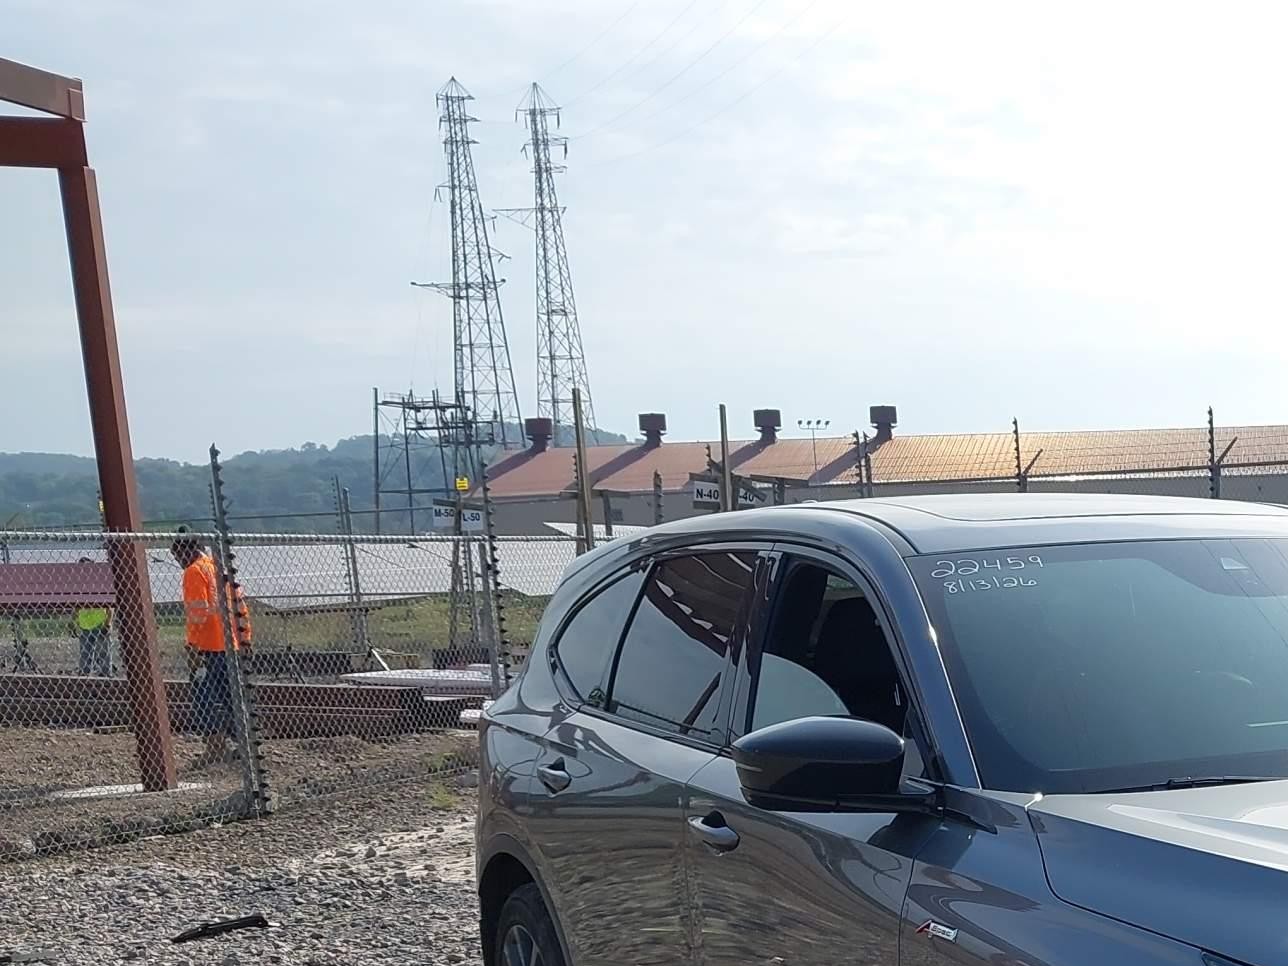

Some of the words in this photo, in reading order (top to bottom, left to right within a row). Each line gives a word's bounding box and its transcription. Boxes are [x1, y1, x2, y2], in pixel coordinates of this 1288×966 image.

[696, 488, 720, 500] N-40
[434, 508, 455, 518] M-50
[463, 512, 481, 522] L-50
[930, 555, 1044, 578] 22459
